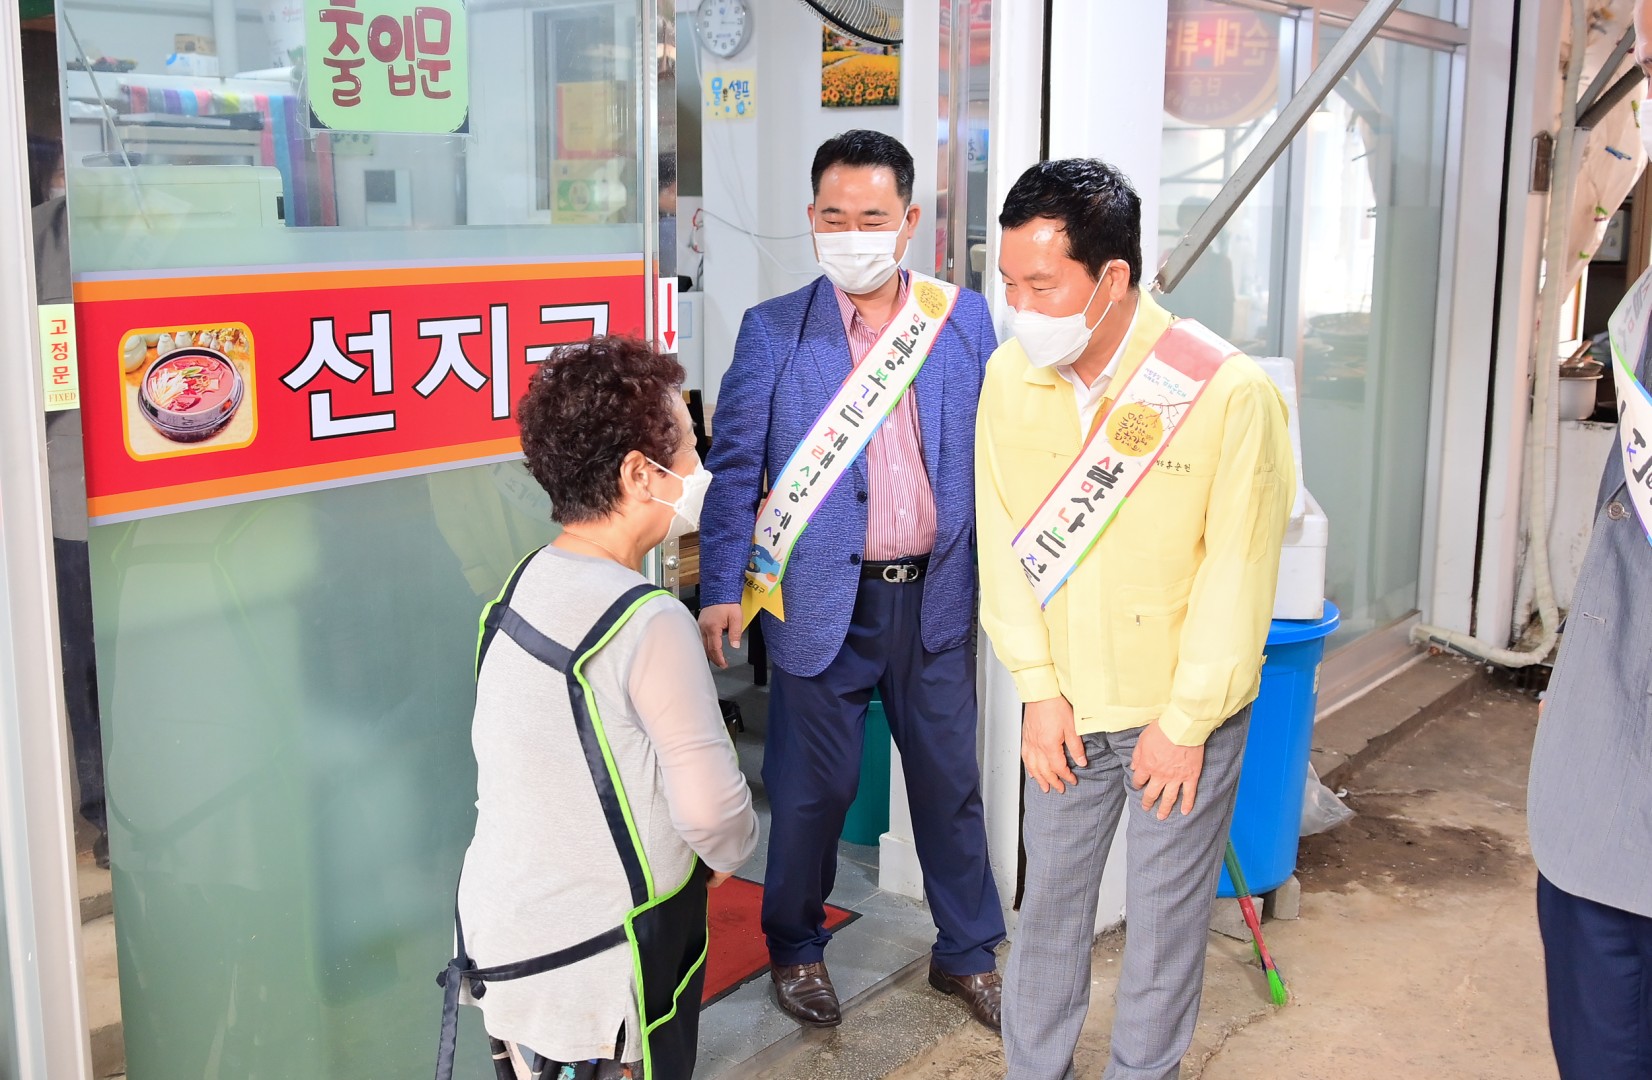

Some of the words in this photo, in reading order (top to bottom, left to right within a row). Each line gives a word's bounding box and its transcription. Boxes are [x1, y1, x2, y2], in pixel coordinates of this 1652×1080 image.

[319, 0, 451, 107] 출입문
[729, 80, 750, 100] 셀프
[50, 319, 70, 384] 고정문
[48, 392, 76, 403] FIXED
[1036, 457, 1124, 559] 살맛나는
